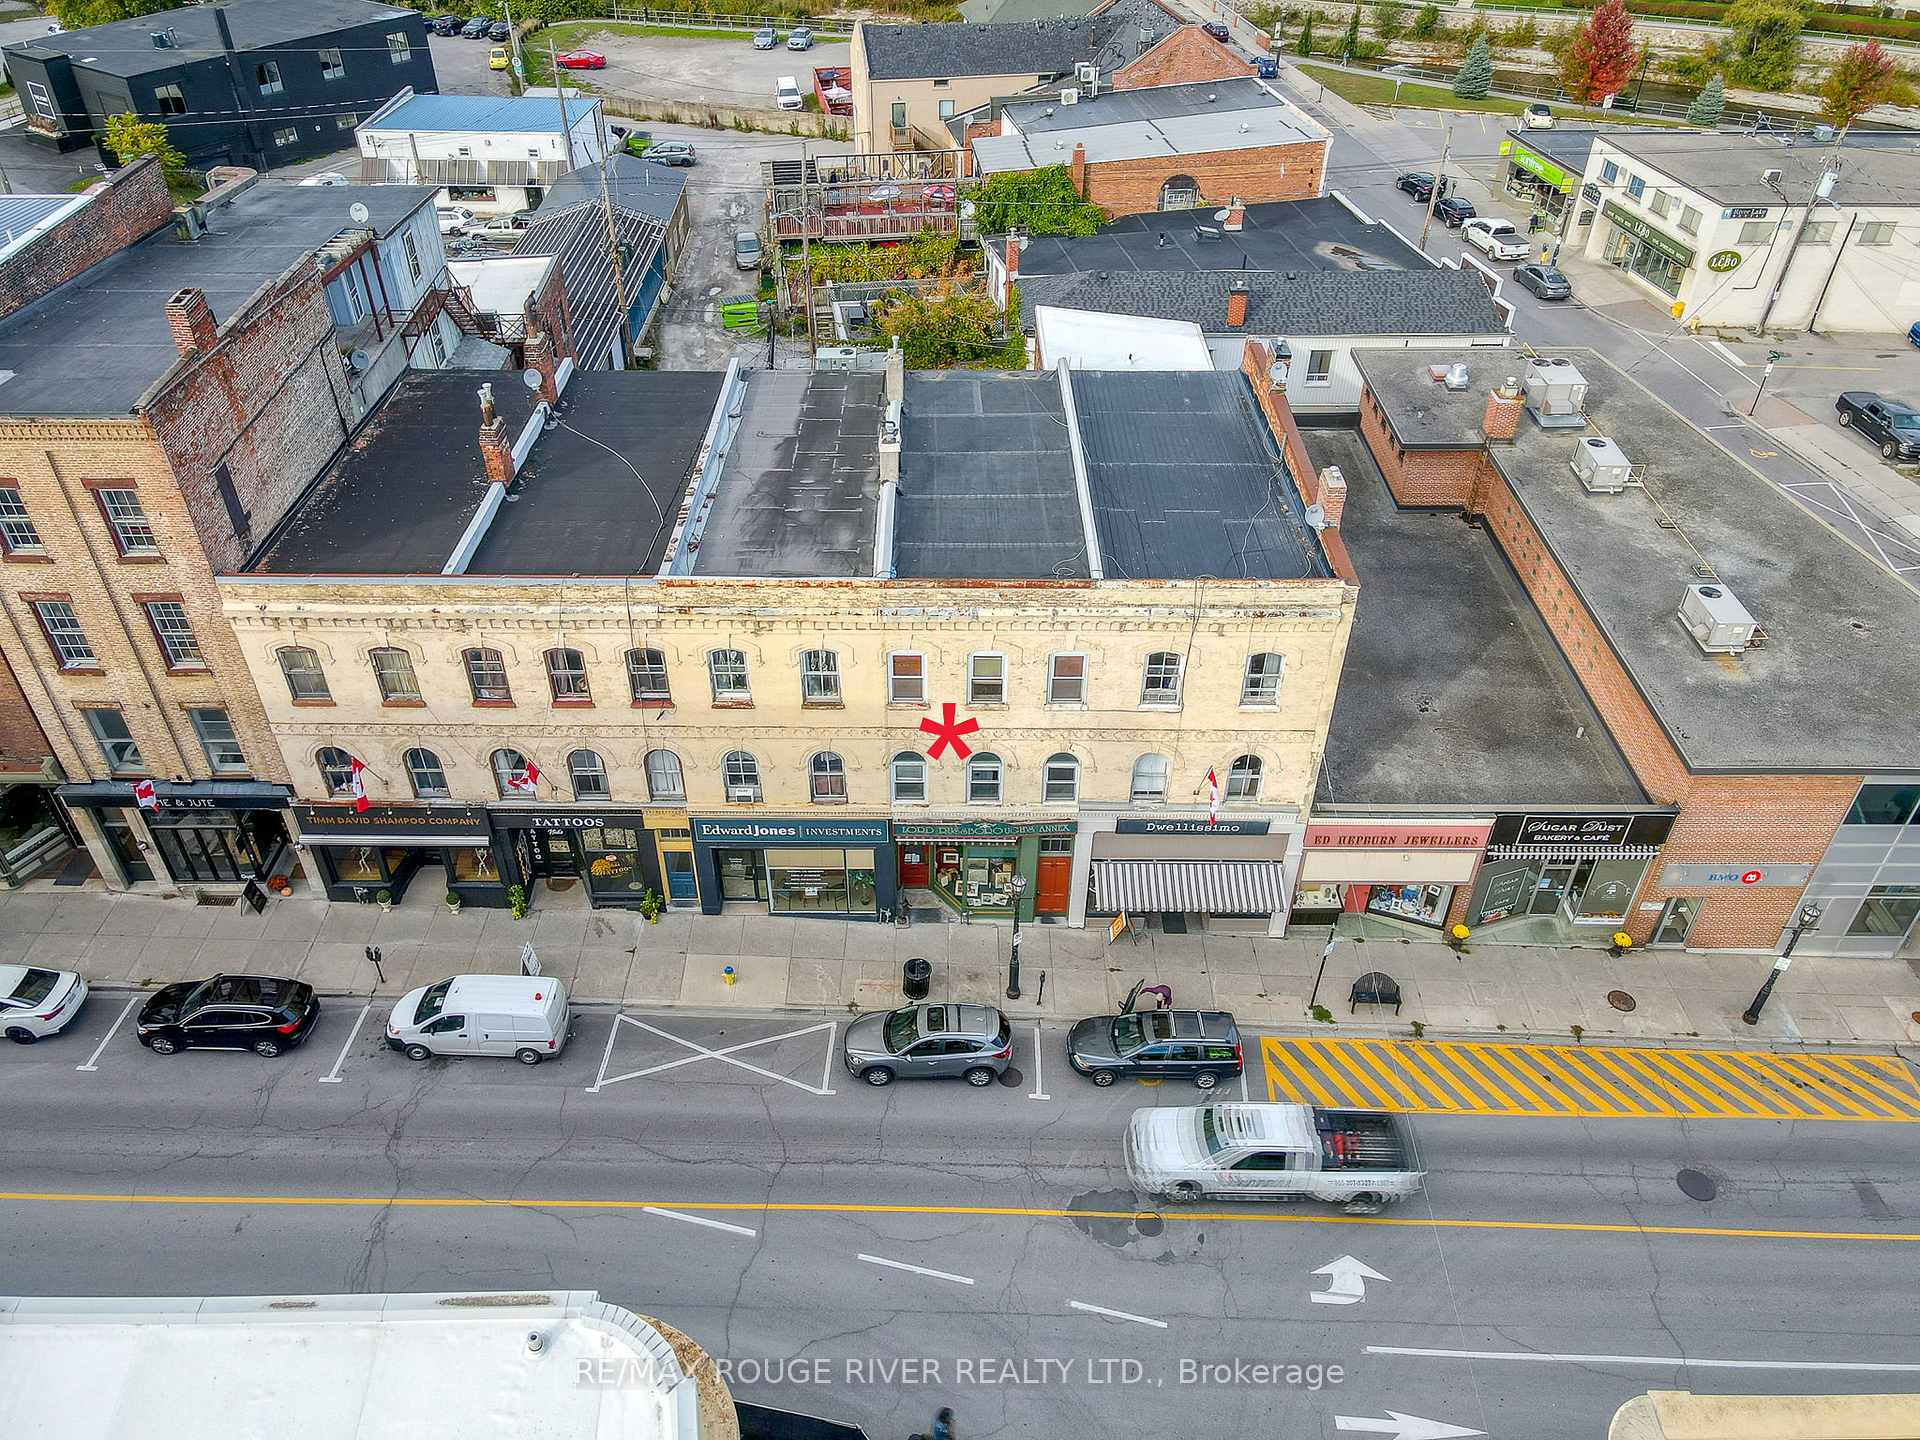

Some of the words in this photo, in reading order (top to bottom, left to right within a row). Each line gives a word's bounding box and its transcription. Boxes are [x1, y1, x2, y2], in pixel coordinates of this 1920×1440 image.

[1711, 257, 1738, 268] LCBO
[187, 799, 215, 808] JUTE
[306, 816, 336, 825] TIMM
[337, 817, 371, 825] DAVID
[374, 817, 426, 826] SHAMPOO
[428, 818, 481, 826] COMPANY
[532, 817, 605, 827] TATTOOS
[1039, 824, 1071, 833] ANNEX
[1145, 822, 1240, 833] Dwellissimo
[1527, 820, 1578, 833] SUGAR
[1581, 820, 1625, 832] DUST
[805, 828, 882, 837] INVESTMENTS
[1313, 836, 1331, 844] ED
[1338, 836, 1398, 845] HEPBURN
[1403, 836, 1479, 846] JEWELLERS
[1708, 872, 1740, 881] BMO
